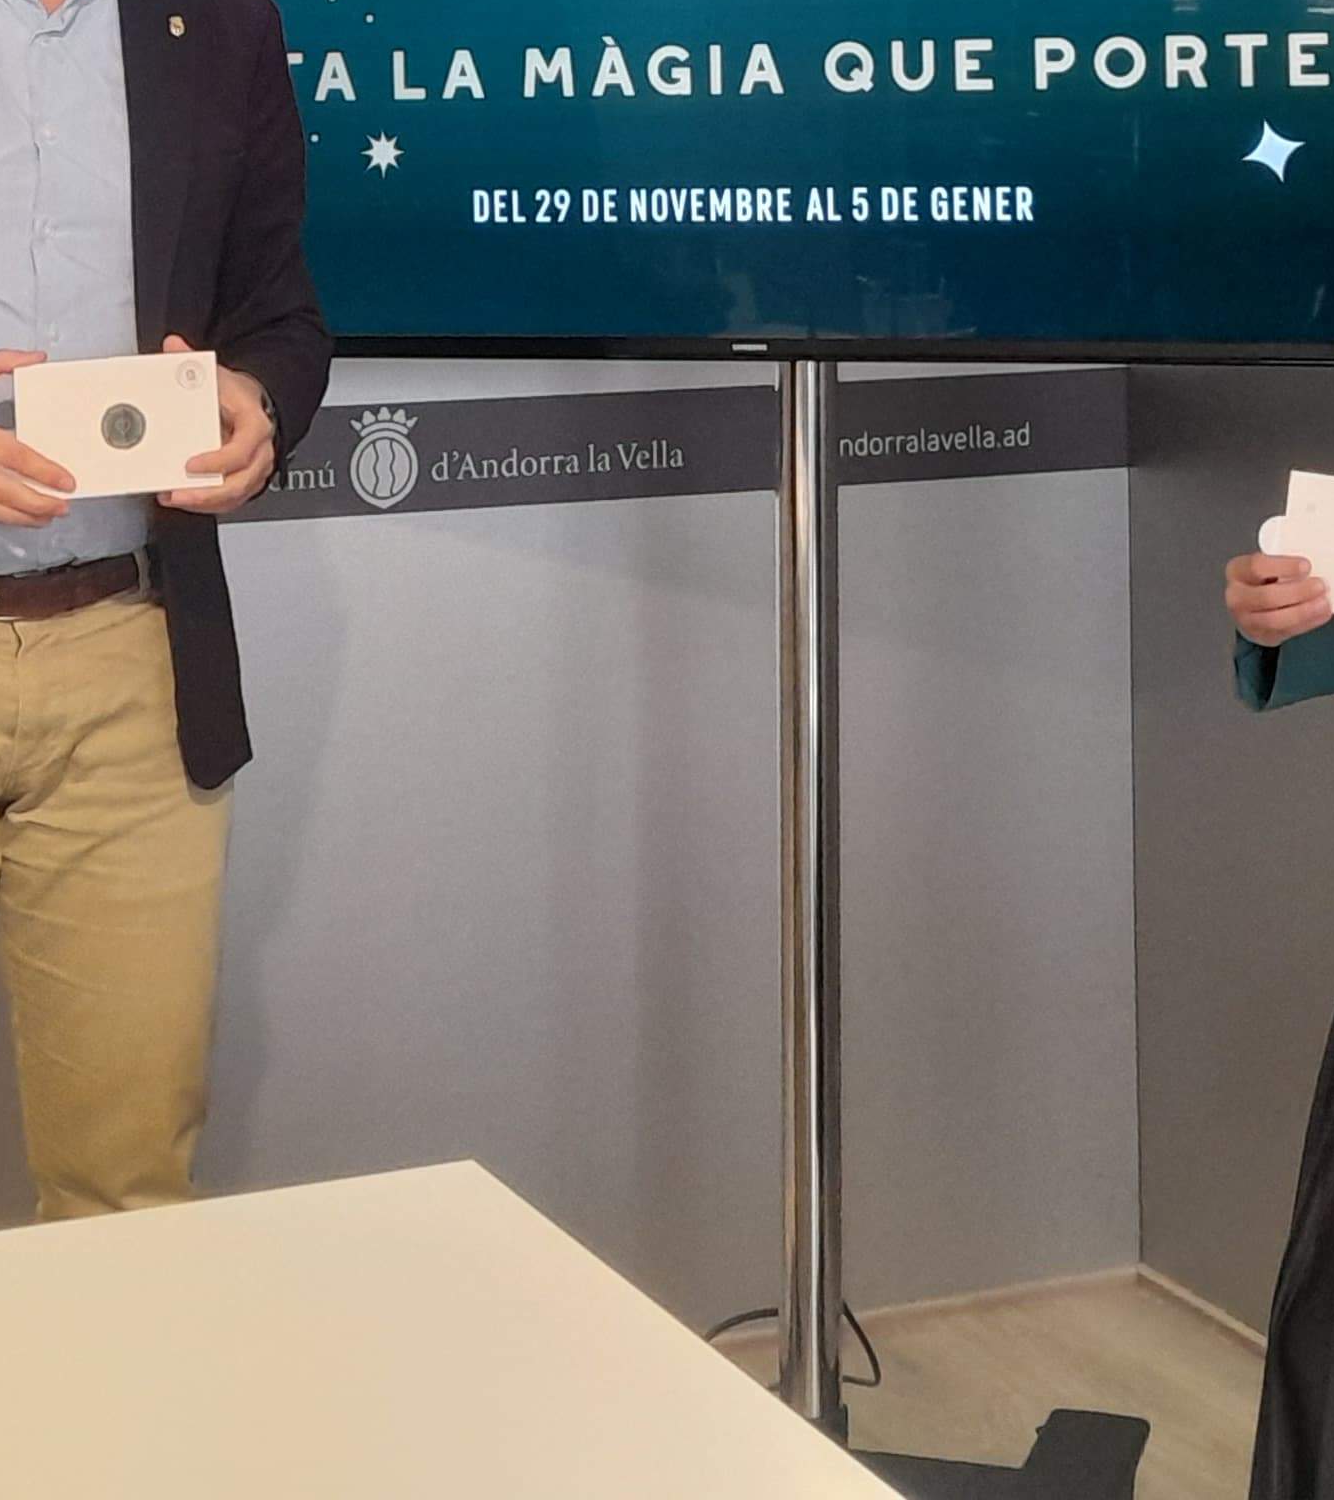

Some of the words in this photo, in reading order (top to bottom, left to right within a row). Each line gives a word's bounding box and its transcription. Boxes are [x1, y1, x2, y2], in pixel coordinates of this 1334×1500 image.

[393, 49, 485, 100] LA
[524, 36, 784, 98] MÀGIA
[824, 38, 994, 93] QUE
[473, 189, 526, 223] DEL
[535, 189, 571, 223] 29
[582, 188, 618, 223] DE
[630, 187, 792, 223] NOVEMBRE
[806, 187, 842, 222] AL
[852, 186, 869, 222] 5
[881, 186, 919, 221] DE
[930, 186, 1034, 222] GENER
[431, 448, 579, 481] d'Andorra
[588, 444, 611, 473] la
[616, 440, 684, 470] Vella
